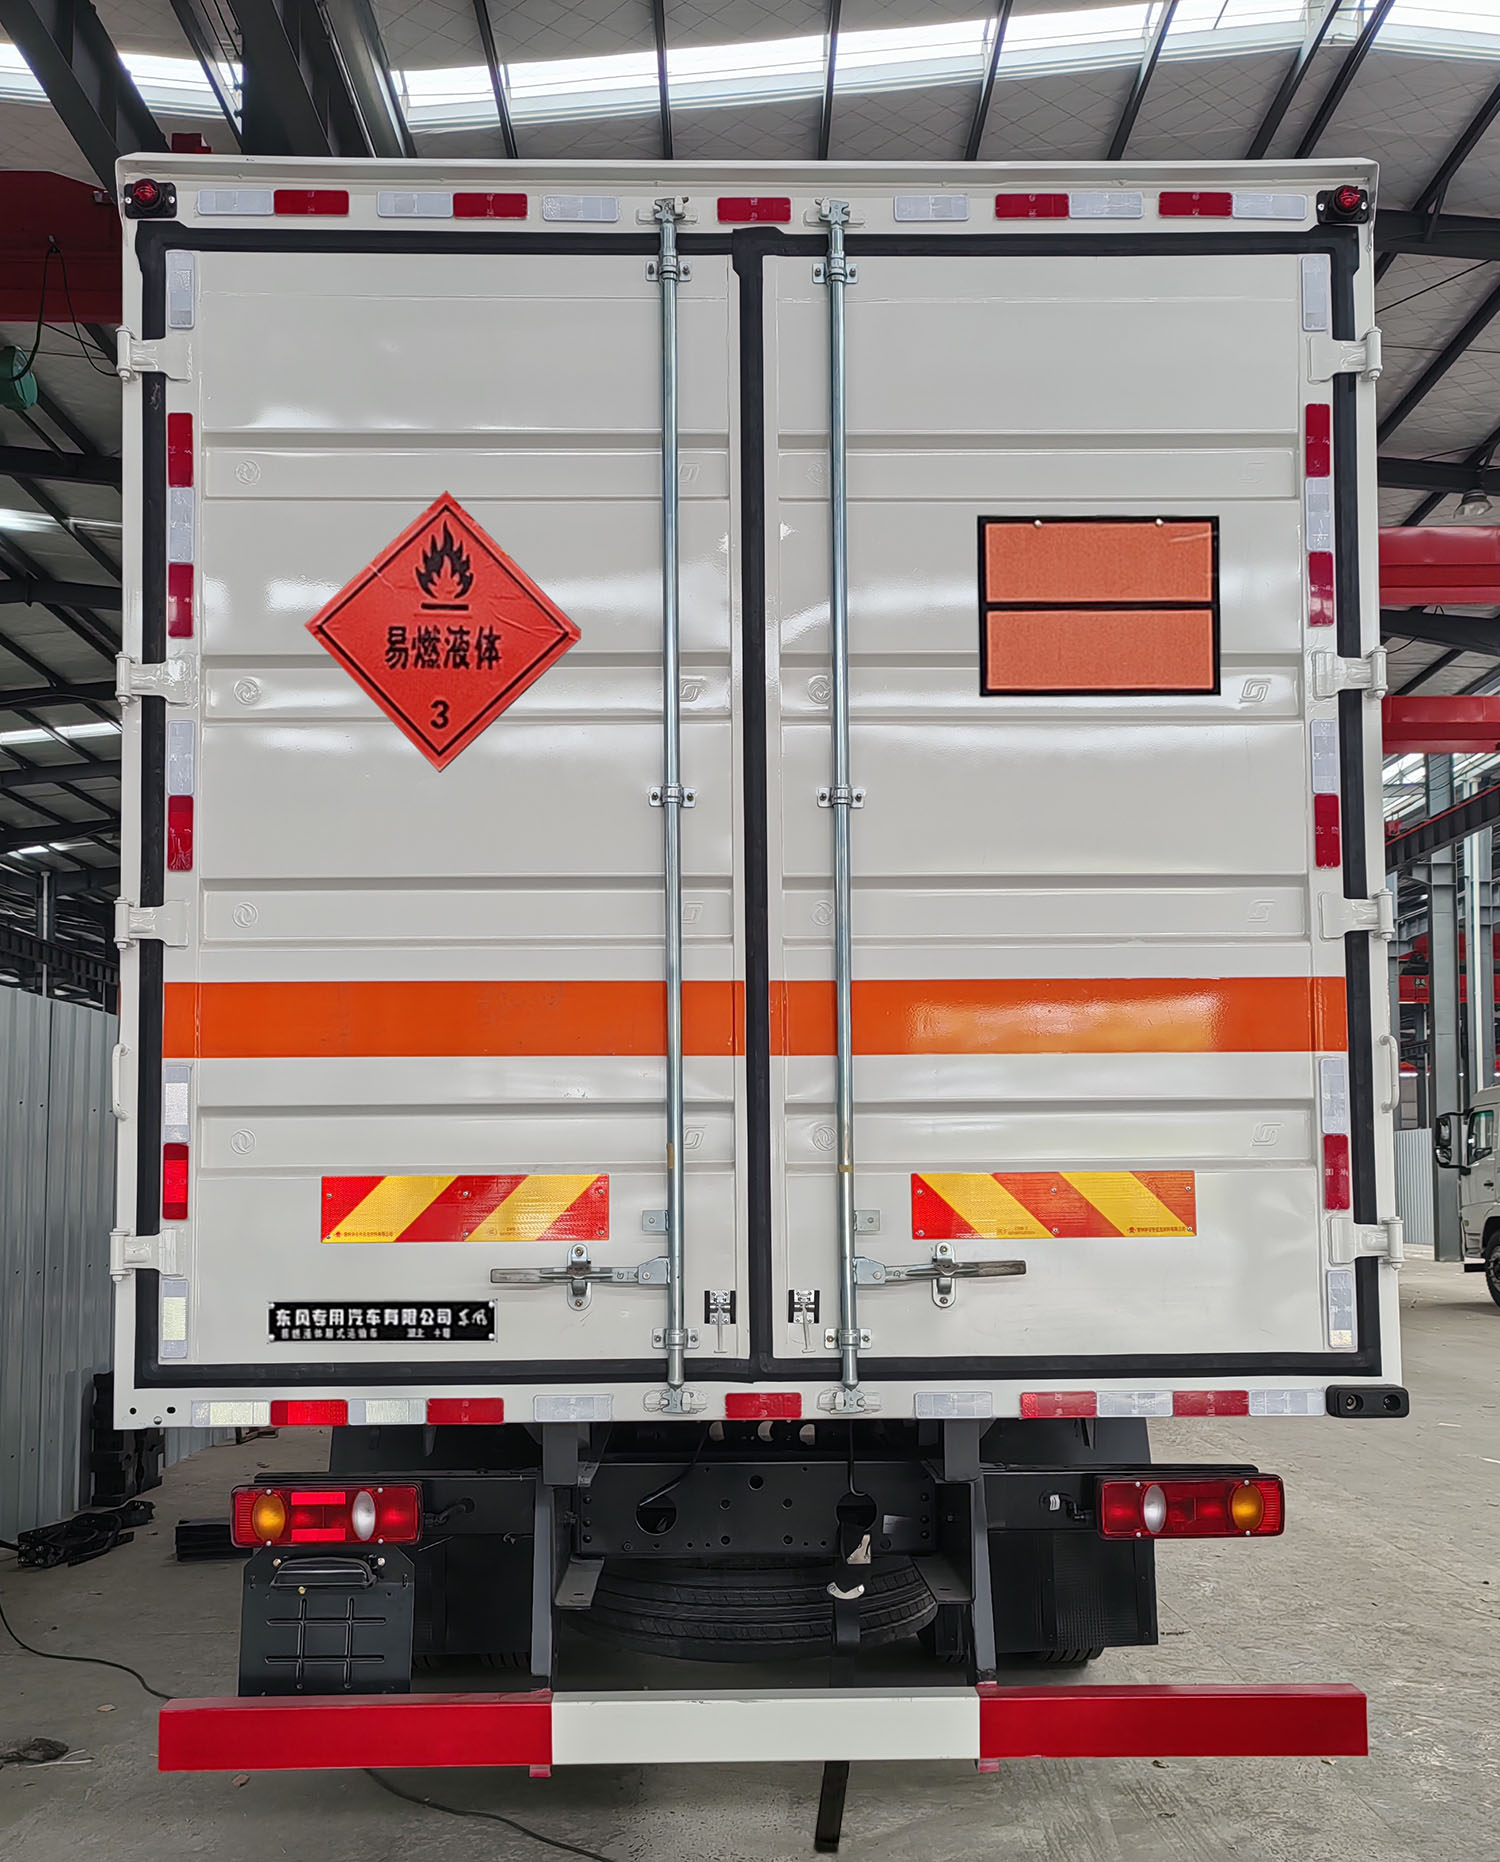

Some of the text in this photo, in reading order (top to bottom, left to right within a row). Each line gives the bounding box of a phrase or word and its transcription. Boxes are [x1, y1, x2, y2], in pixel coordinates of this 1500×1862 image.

[384, 625, 502, 670] 易燃液体
[430, 700, 449, 729] 3
